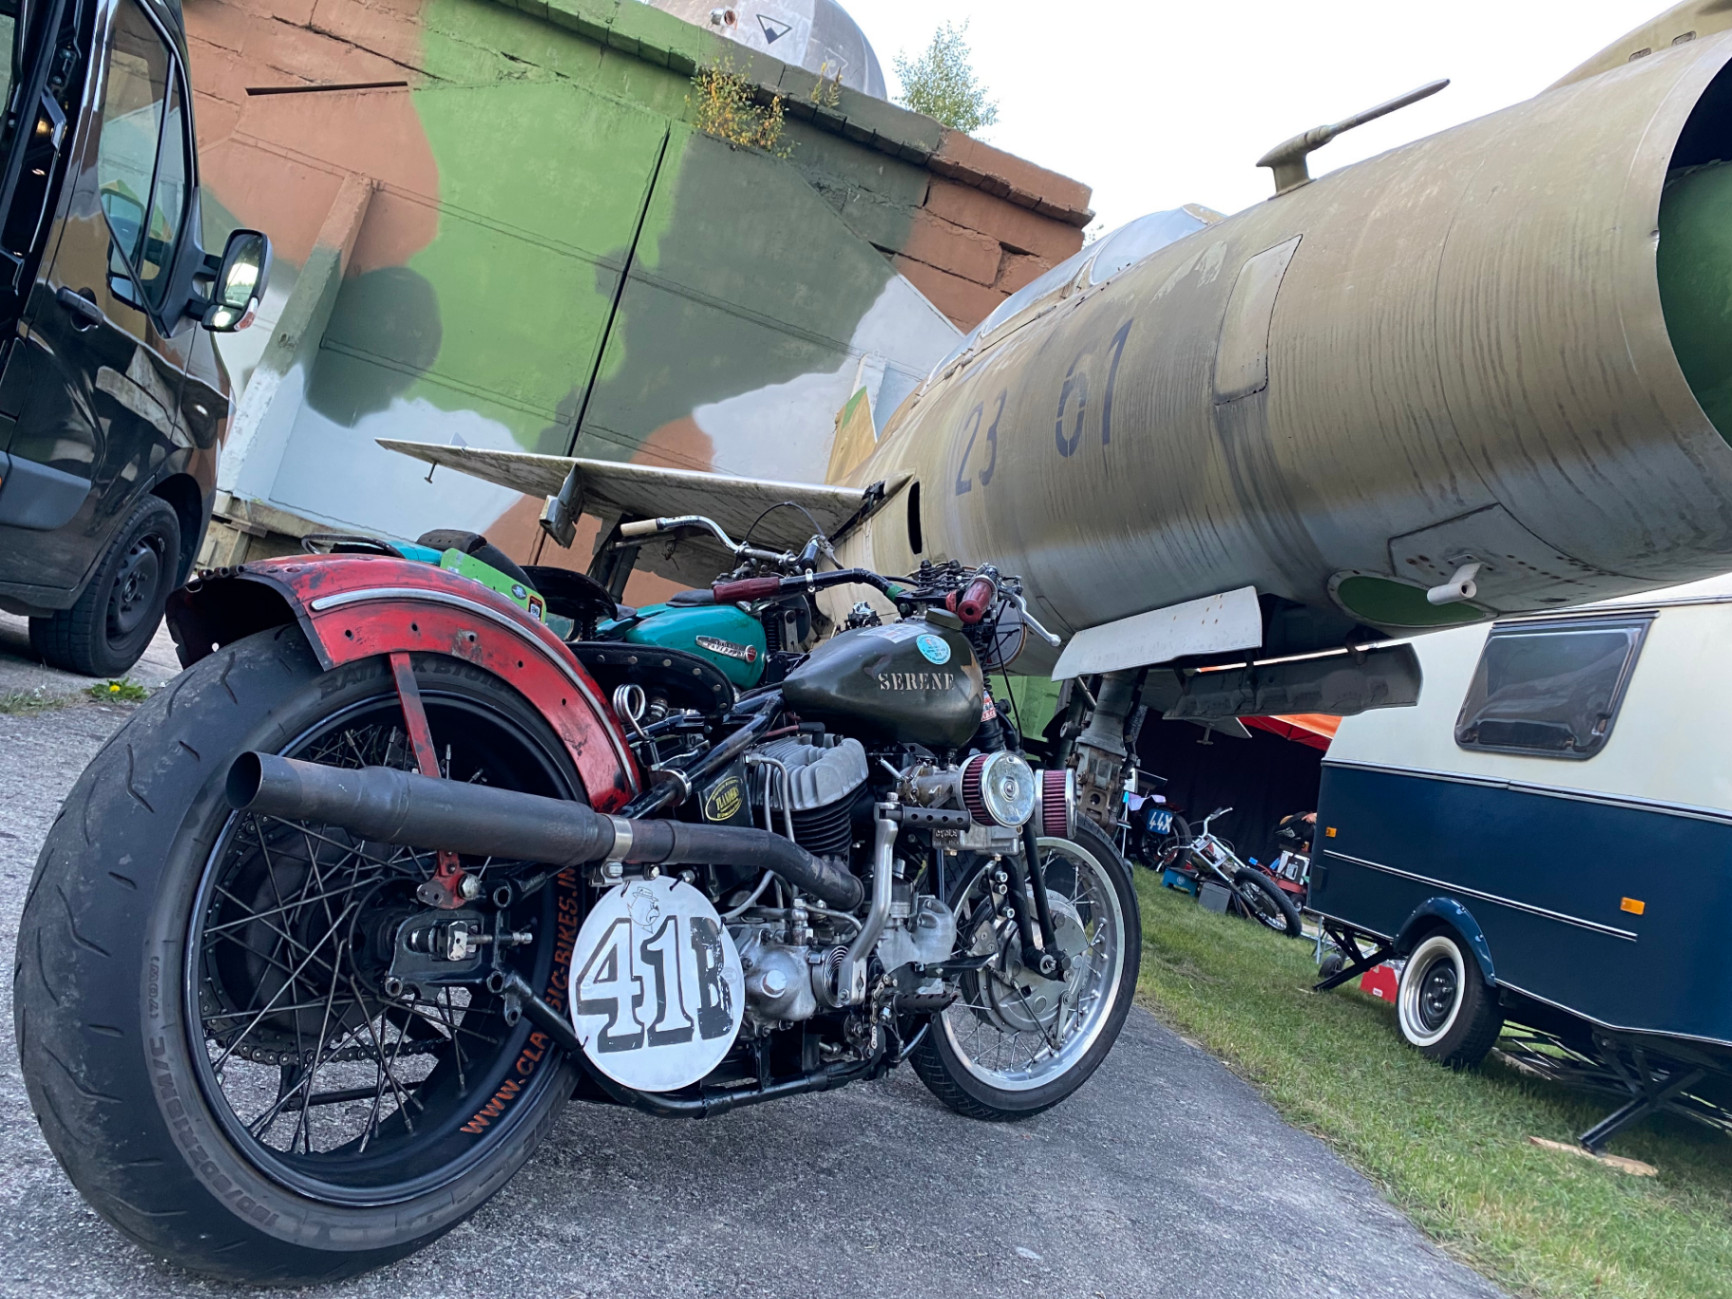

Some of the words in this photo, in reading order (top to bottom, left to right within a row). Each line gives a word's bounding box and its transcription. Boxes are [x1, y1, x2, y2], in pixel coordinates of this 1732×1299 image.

[956, 386, 1007, 496] 23
[878, 672, 954, 691] SERENE
[1149, 811, 1173, 833] 44X
[576, 915, 734, 1054] 41B
